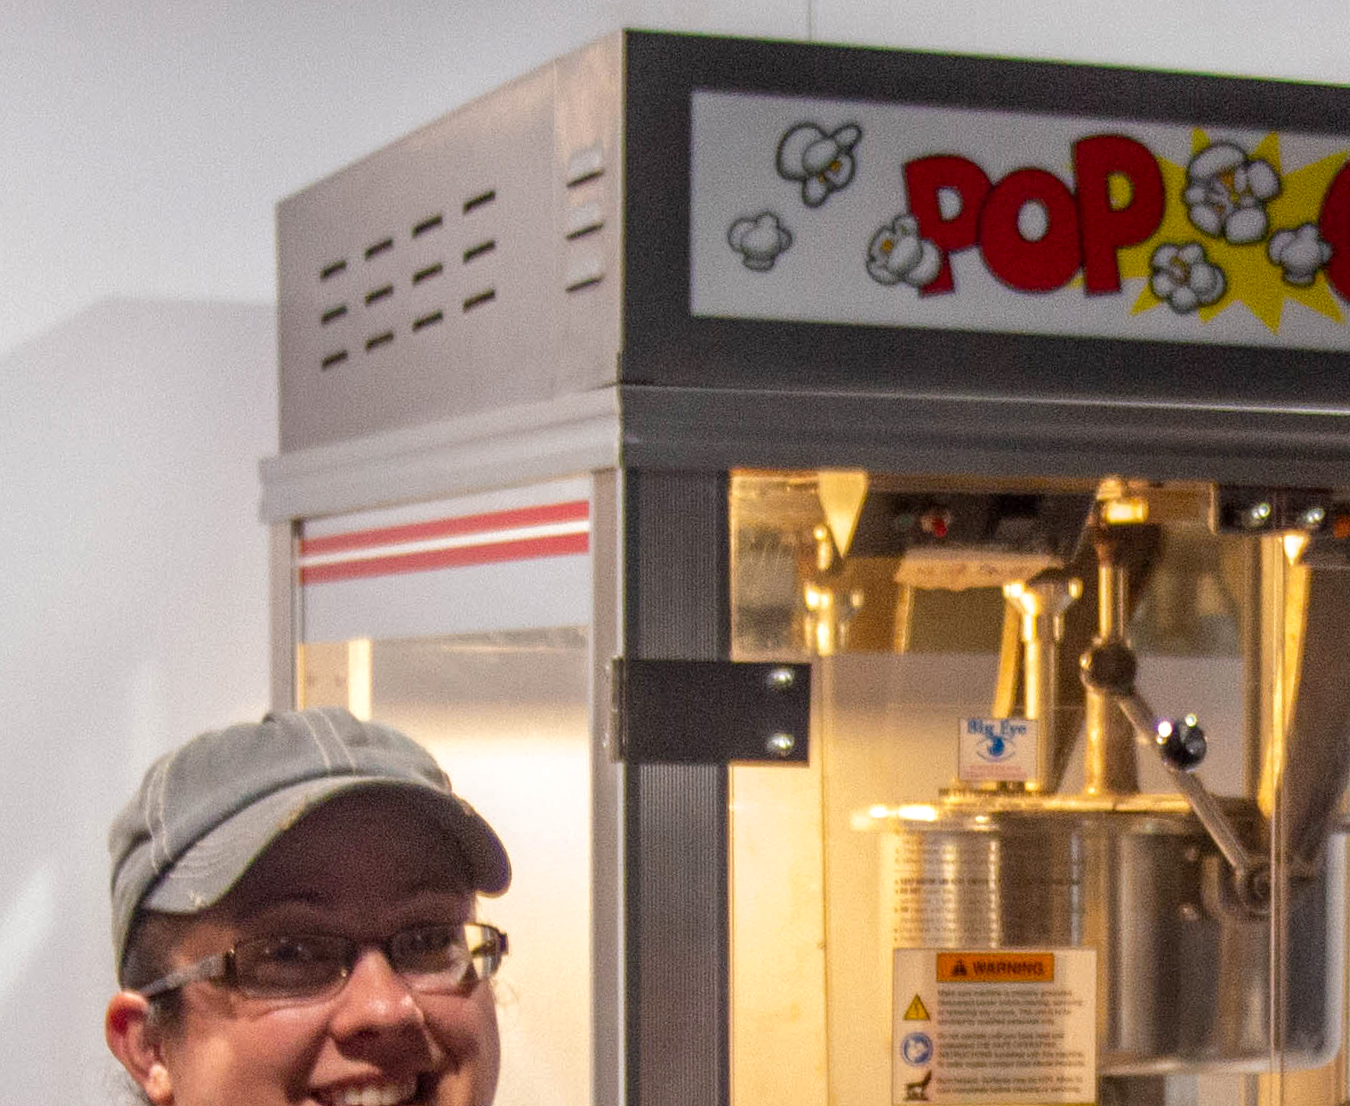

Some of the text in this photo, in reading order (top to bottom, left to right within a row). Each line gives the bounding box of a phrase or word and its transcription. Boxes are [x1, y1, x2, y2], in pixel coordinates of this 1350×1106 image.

[902, 134, 1165, 298] POP
[967, 717, 1027, 738] Big Eye
[972, 960, 1044, 976] WARNING
